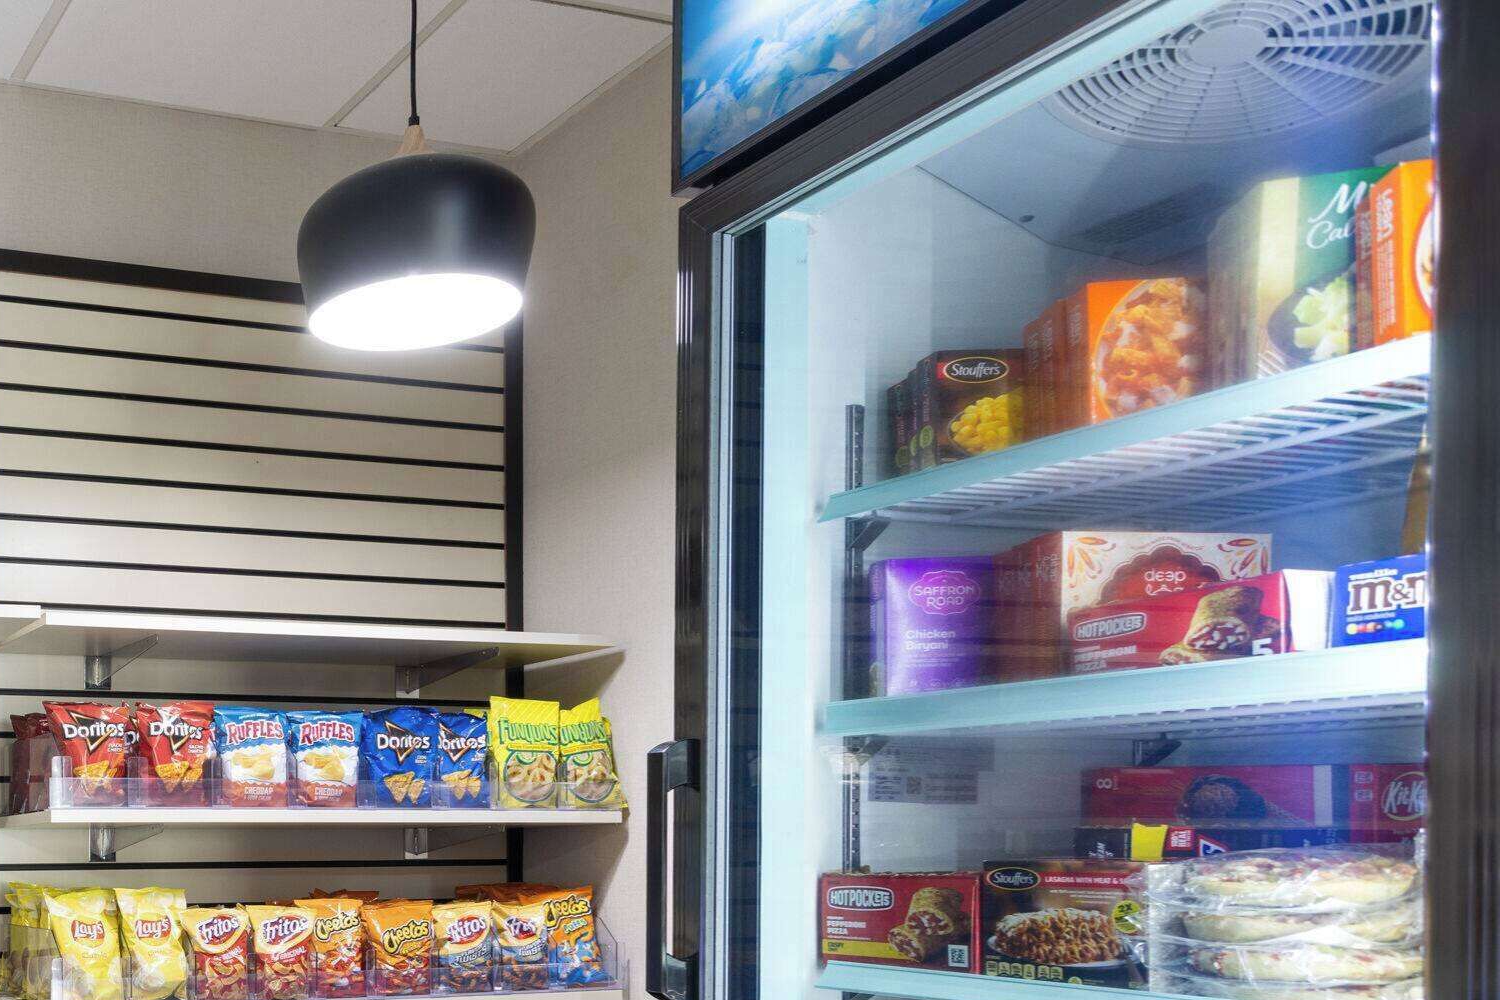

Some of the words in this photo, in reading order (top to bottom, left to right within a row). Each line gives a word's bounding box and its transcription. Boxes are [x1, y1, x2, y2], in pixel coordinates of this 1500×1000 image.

[951, 362, 1002, 380] Stouffer's
[913, 585, 975, 597] SAFFRON
[926, 597, 965, 610] ROAD
[905, 629, 956, 639] Chicken
[1077, 622, 1098, 639] HOT
[1099, 615, 1143, 637] POCKETS
[905, 639, 949, 652] Biryani
[1251, 638, 1274, 656] 5
[63, 721, 125, 740] Doritos
[149, 720, 205, 741] Doritos
[225, 720, 285, 746] RUFFLES
[300, 720, 356, 746] RUFFLES
[498, 717, 559, 745] FUNYUNS
[561, 720, 607, 745] UNYUNS
[377, 733, 431, 750] Doritos
[244, 786, 274, 795] CHEDDAR
[992, 871, 1035, 887] Stouffer's
[1044, 876, 1075, 884] LASAGNA
[1075, 876, 1093, 884] WITH
[1093, 877, 1113, 885] MEAT
[830, 889, 849, 906] HOT
[849, 889, 891, 907] POCKETS
[544, 894, 592, 929] Cheetos
[73, 921, 104, 941] Lay's
[136, 915, 171, 938] Lay's
[195, 915, 240, 944] Fritos
[261, 915, 310, 944] Fritos
[314, 912, 361, 942] Cheetos
[382, 919, 430, 954] Cheetos
[447, 917, 487, 943] Fritos
